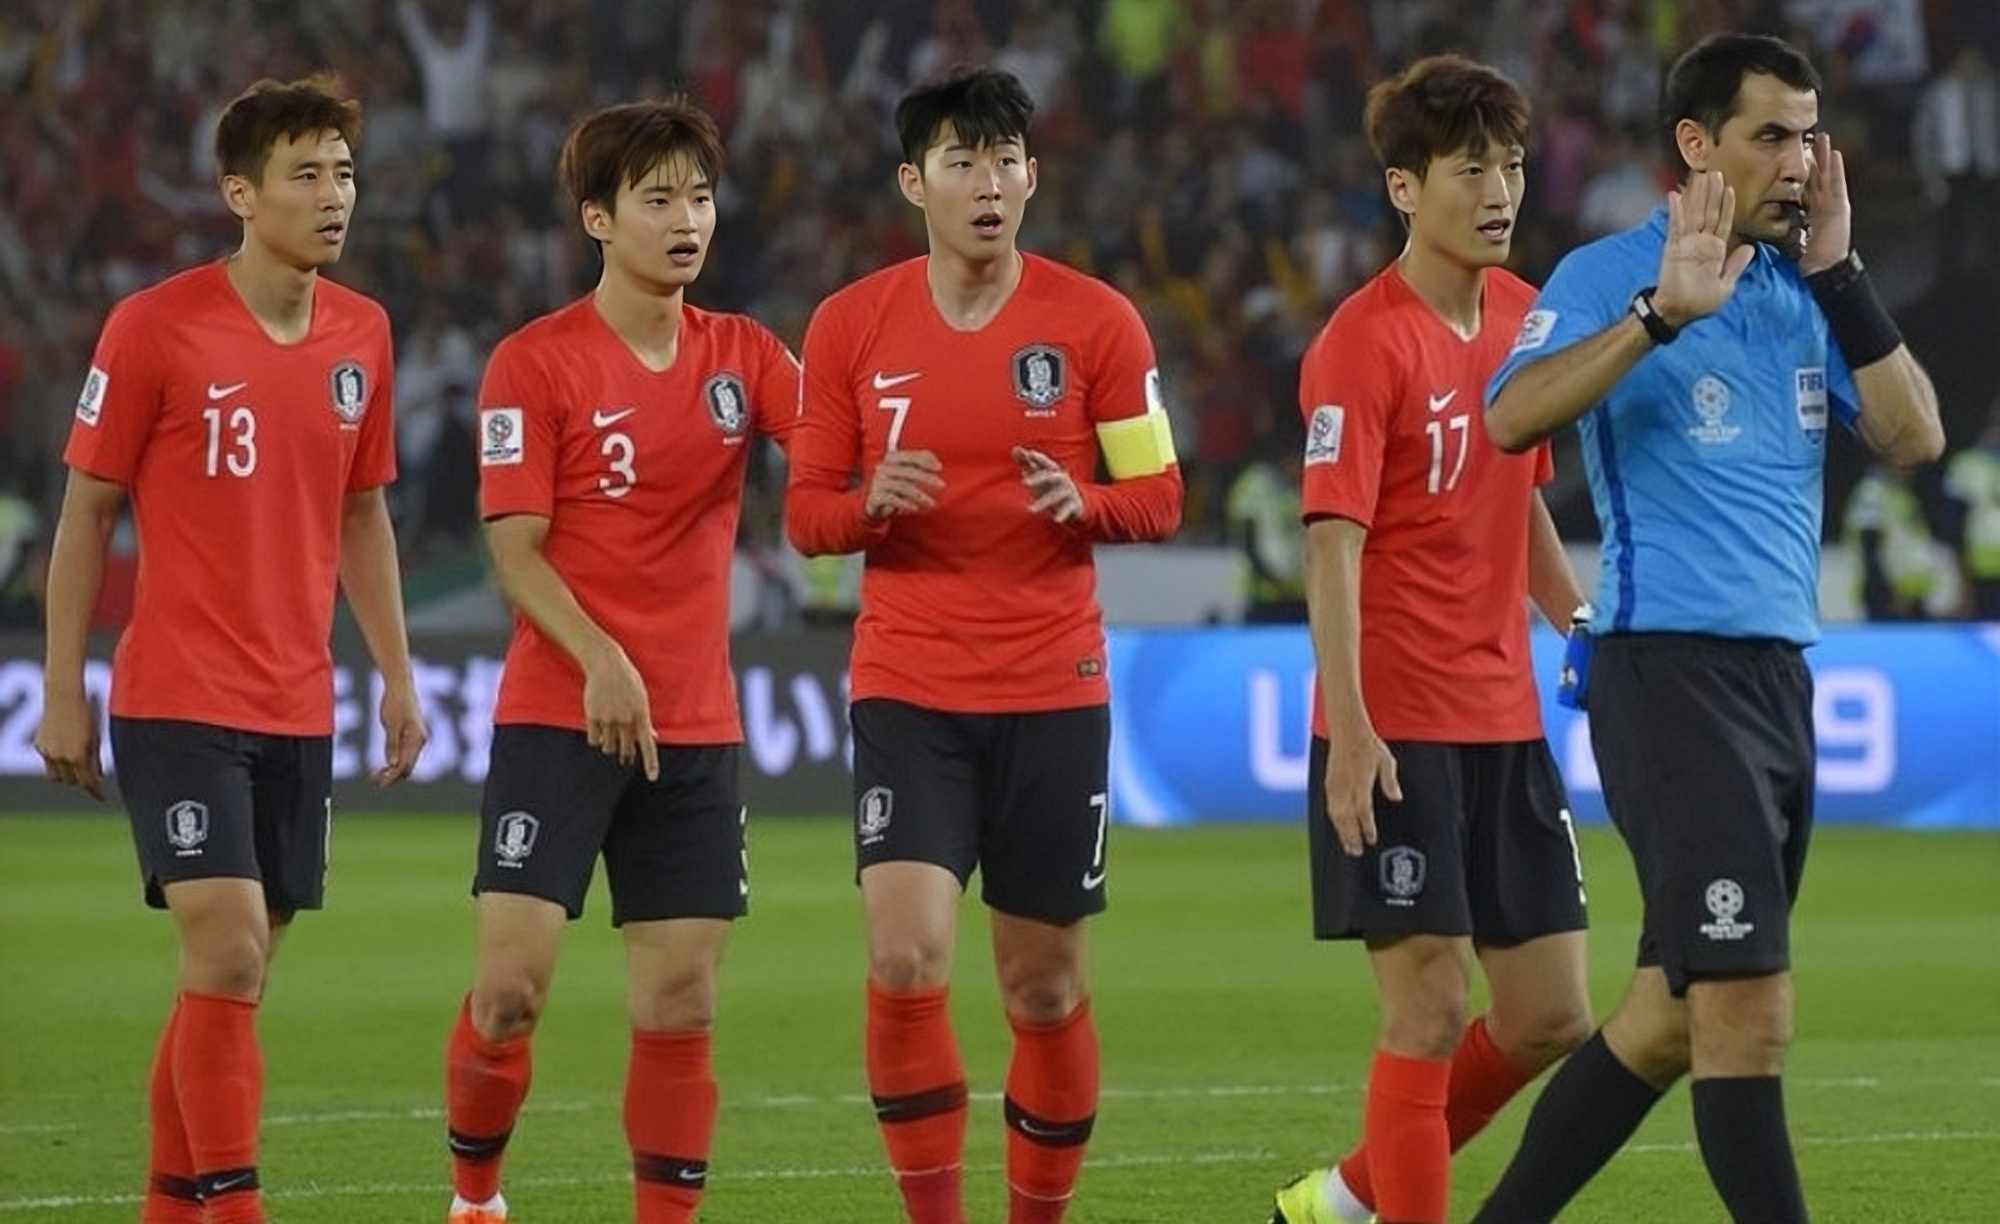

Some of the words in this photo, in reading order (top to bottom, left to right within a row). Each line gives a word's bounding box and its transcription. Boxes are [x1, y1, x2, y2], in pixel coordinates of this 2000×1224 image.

[203, 406, 258, 478] 13
[878, 397, 912, 451] 7
[1425, 414, 1470, 495] 17
[600, 432, 637, 498] 3
[1090, 792, 1106, 866] 7
